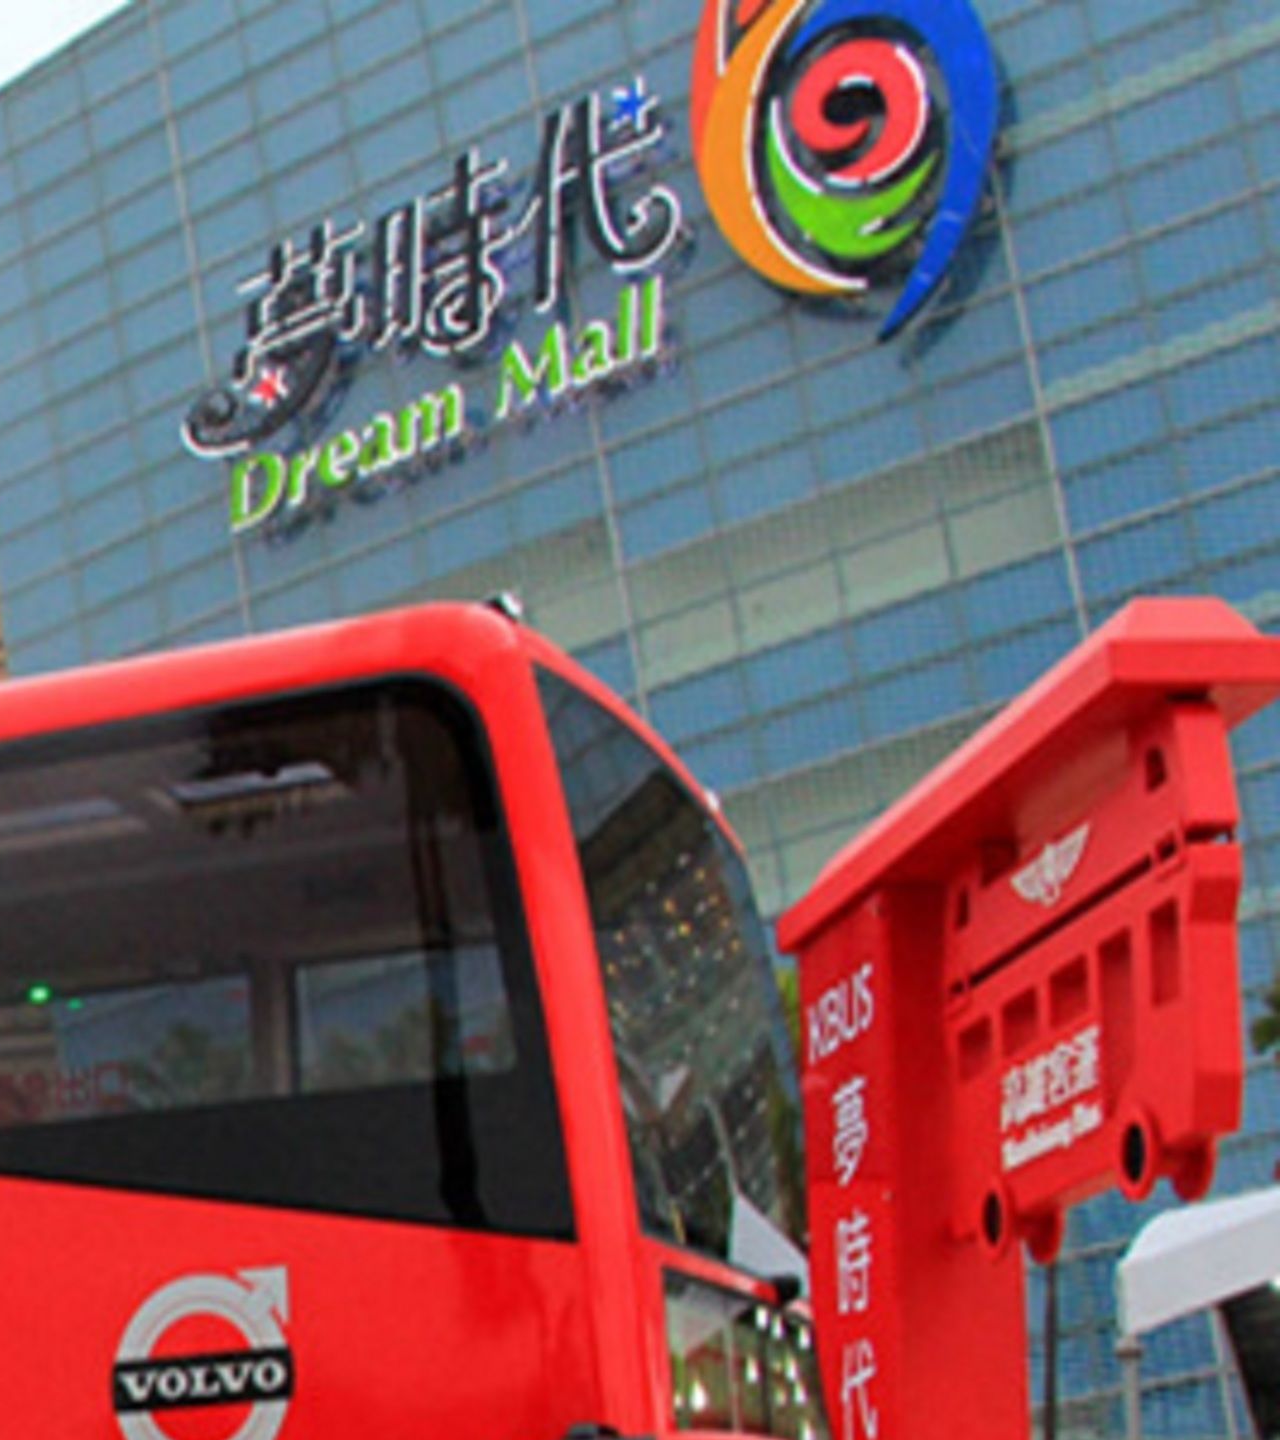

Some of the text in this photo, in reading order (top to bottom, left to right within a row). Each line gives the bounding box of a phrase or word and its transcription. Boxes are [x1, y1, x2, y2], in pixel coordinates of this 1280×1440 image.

[229, 275, 663, 533] Dream Mall
[808, 962, 874, 1065] KBUS
[118, 1357, 287, 1402] VOLVO
